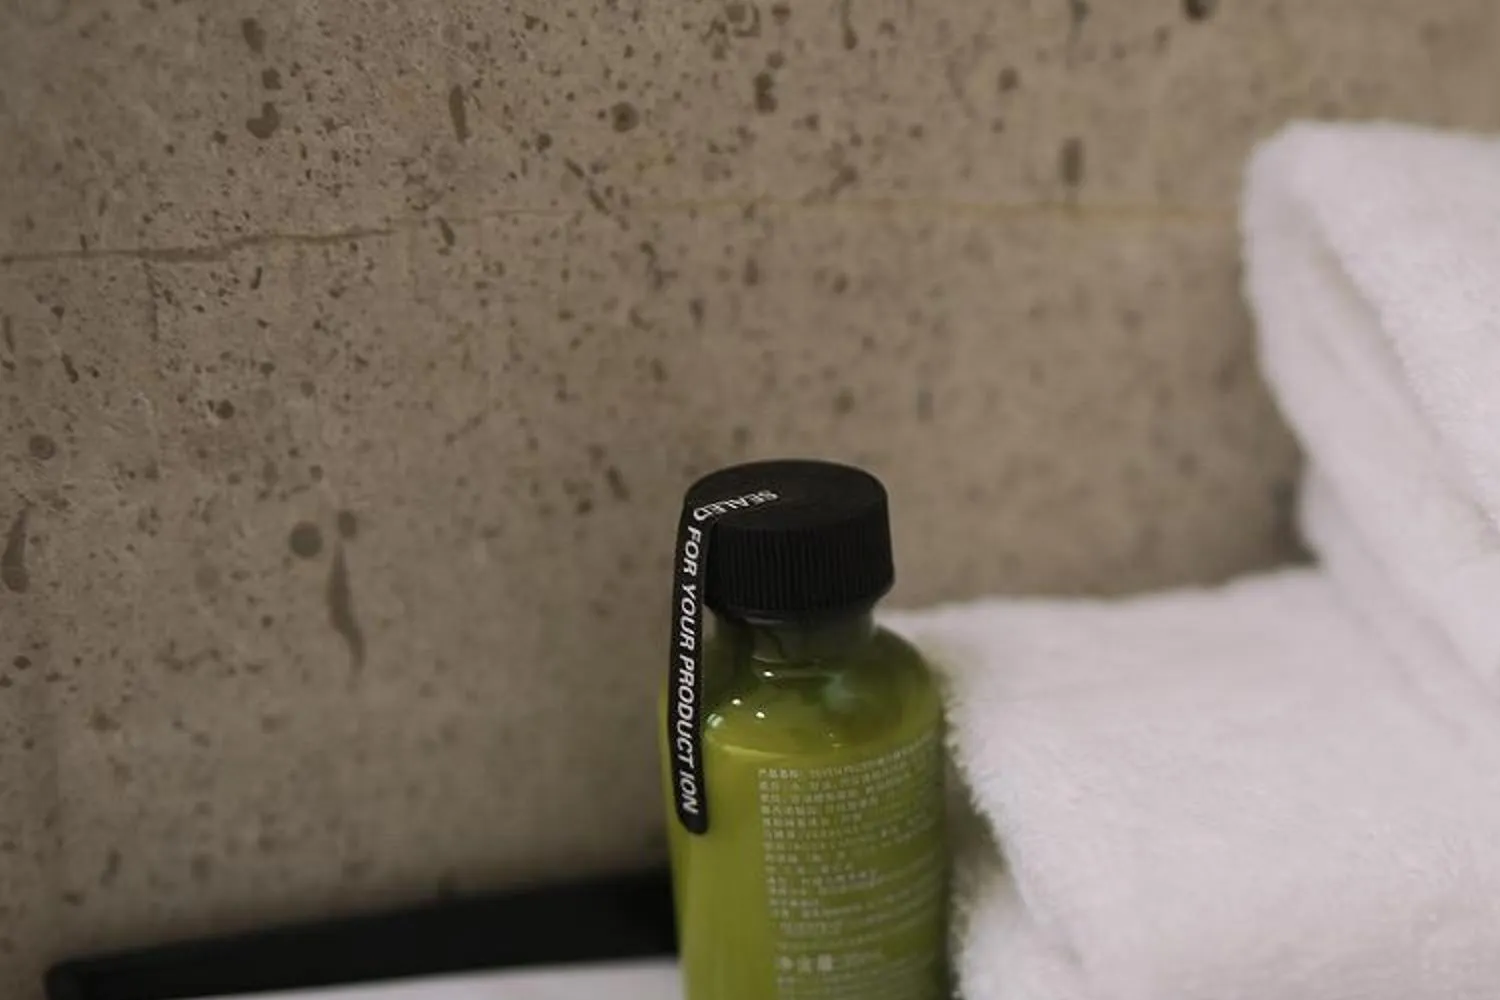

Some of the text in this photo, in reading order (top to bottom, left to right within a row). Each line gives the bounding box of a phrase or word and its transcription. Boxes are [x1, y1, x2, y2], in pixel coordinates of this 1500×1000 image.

[692, 489, 779, 521] SEALED
[683, 525, 702, 577] FOR
[680, 583, 697, 651] YOUR
[678, 654, 695, 769] PRODUCT
